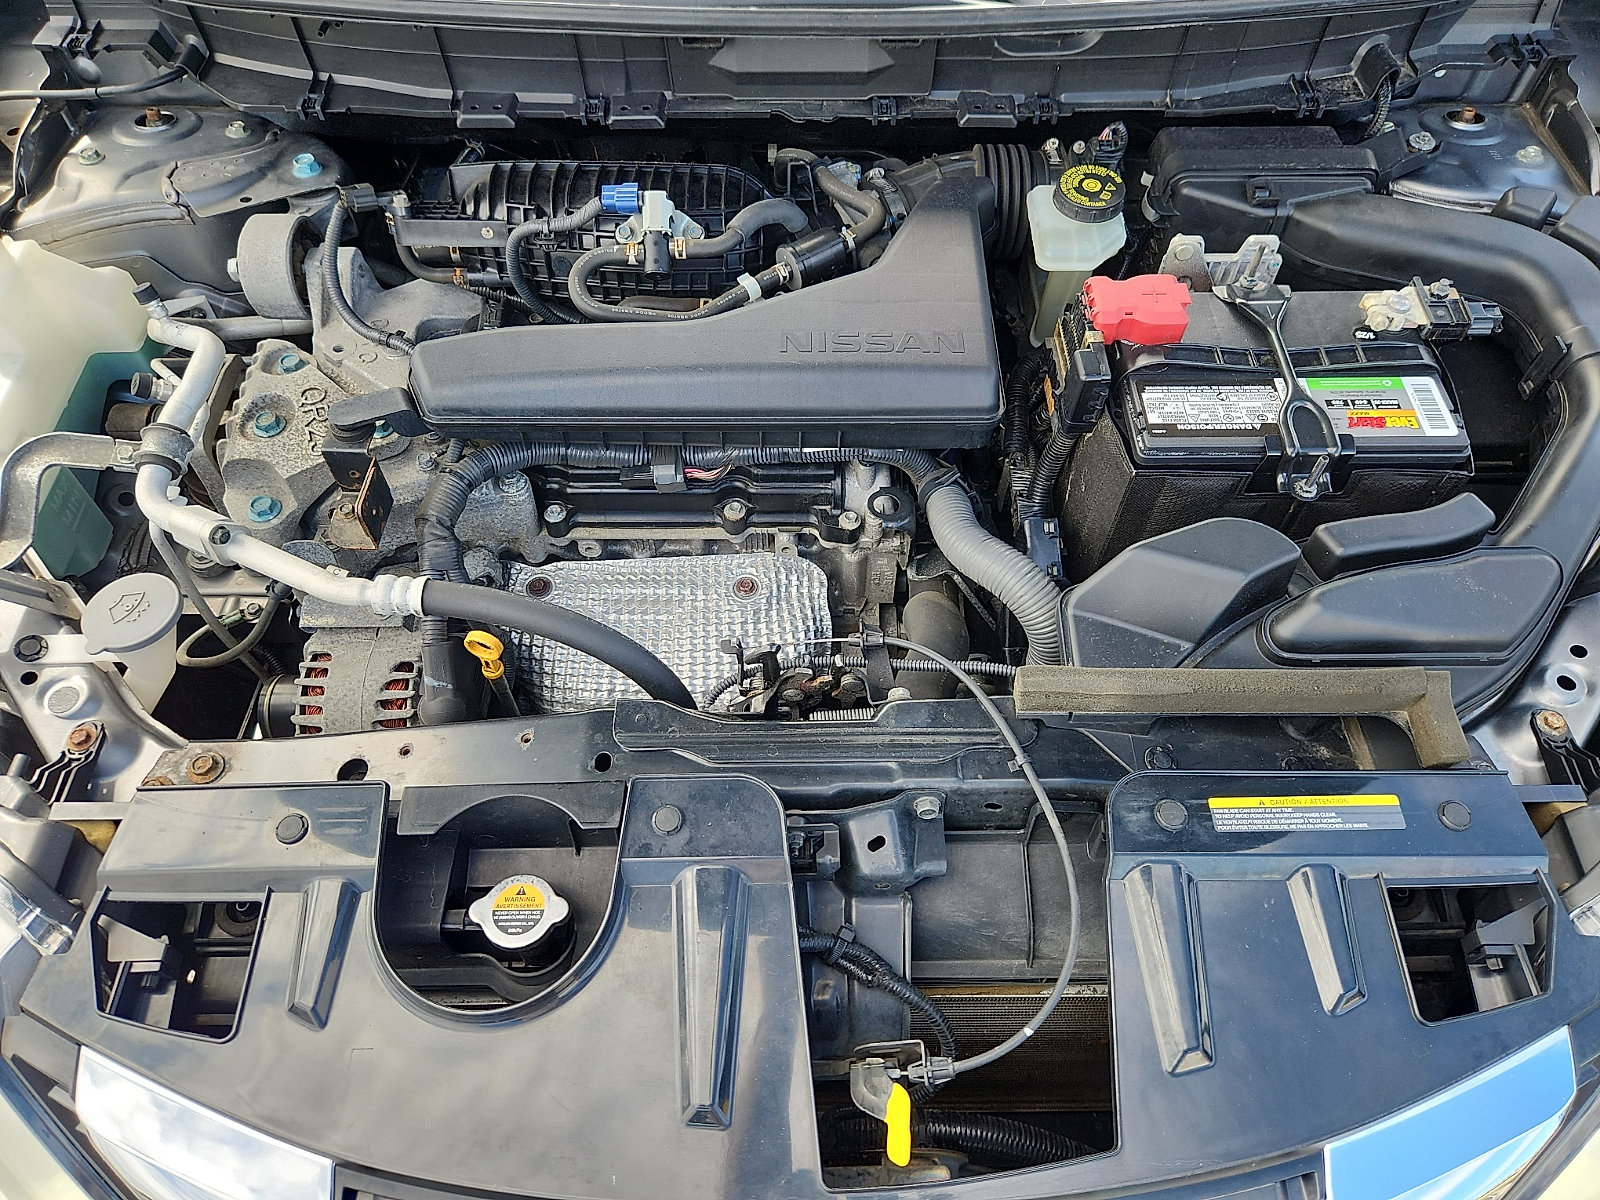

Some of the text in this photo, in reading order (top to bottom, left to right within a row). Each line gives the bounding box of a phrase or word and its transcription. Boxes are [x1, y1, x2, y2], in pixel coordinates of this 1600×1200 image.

[1355, 331, 1375, 339] 1/25
[779, 331, 966, 354] NISSAN
[1348, 416, 1419, 429] EverStart
